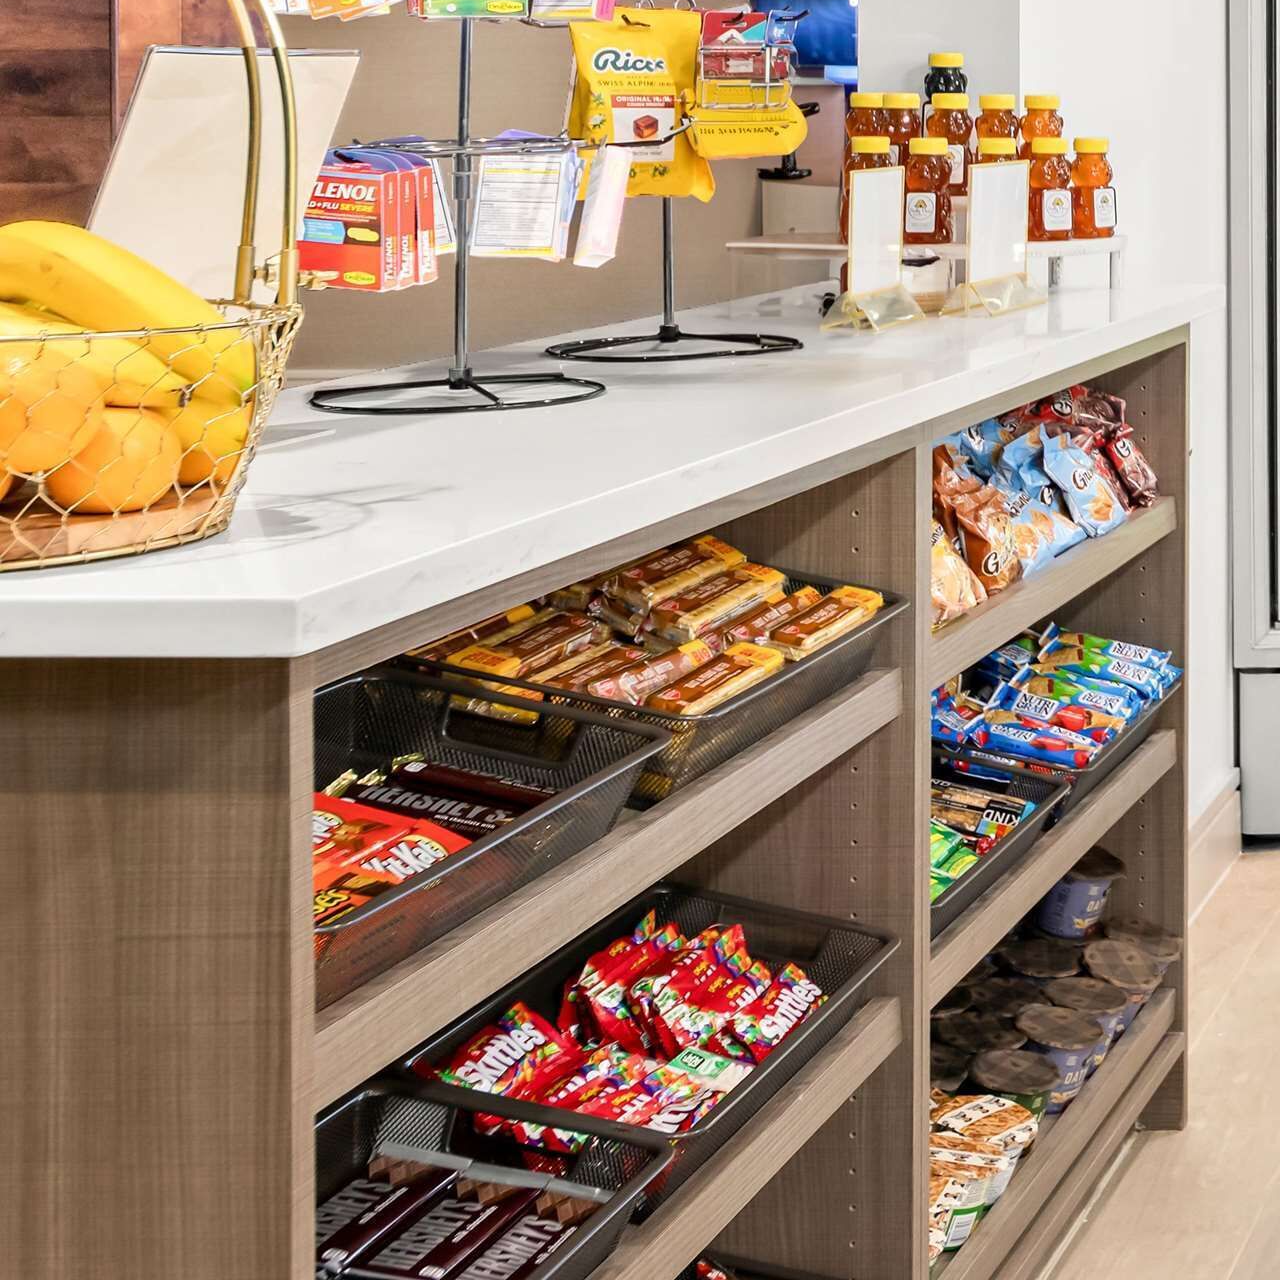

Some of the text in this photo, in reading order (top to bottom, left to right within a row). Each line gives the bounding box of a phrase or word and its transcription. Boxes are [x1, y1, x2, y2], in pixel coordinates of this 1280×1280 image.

[1021, 692, 1057, 710] NUTRI
[982, 808, 1021, 826] KIND
[759, 979, 822, 1046] Skittles
[455, 1021, 547, 1094] Skittles
